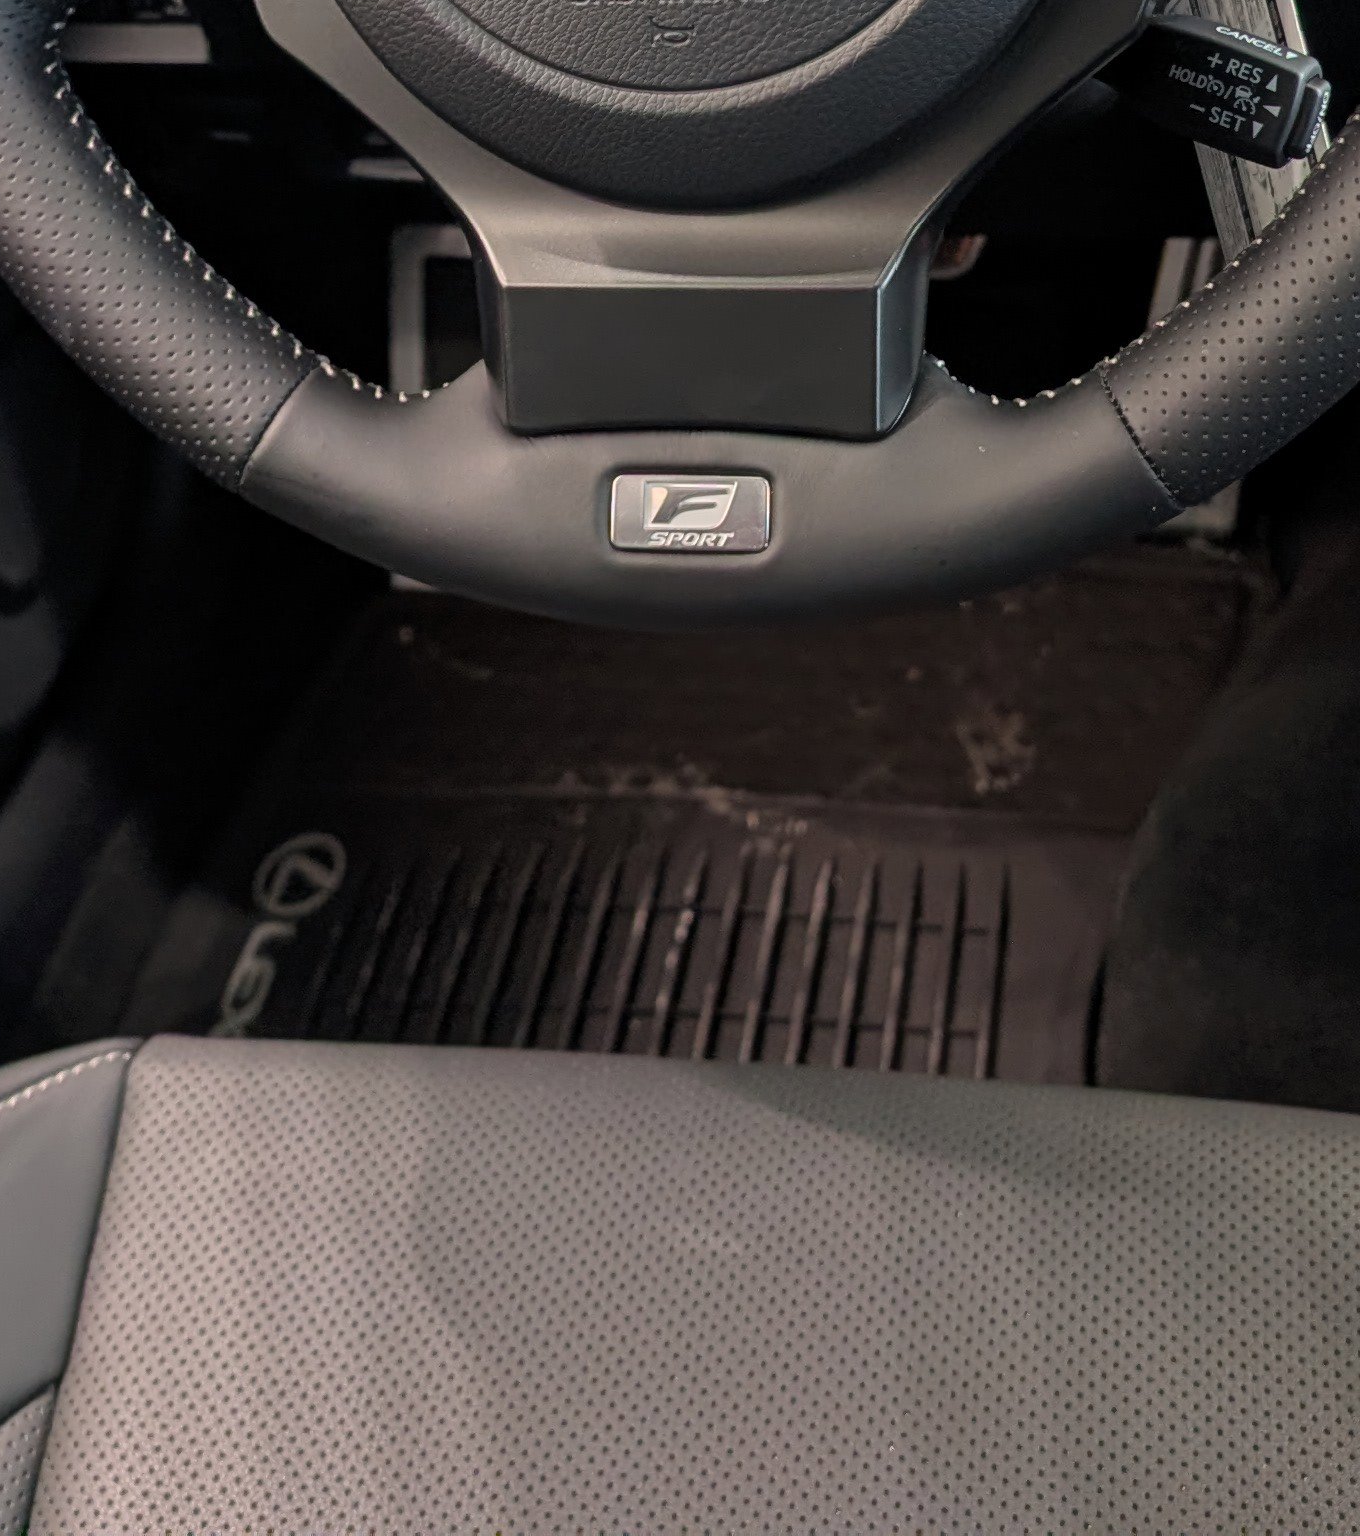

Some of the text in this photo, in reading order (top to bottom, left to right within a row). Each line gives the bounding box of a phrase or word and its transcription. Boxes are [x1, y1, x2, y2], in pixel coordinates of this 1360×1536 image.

[1215, 25, 1283, 57] CANCEL
[1168, 64, 1208, 89] HOLD
[1225, 57, 1264, 85] RES
[1208, 106, 1246, 133] SET
[647, 530, 735, 547] SPORT
